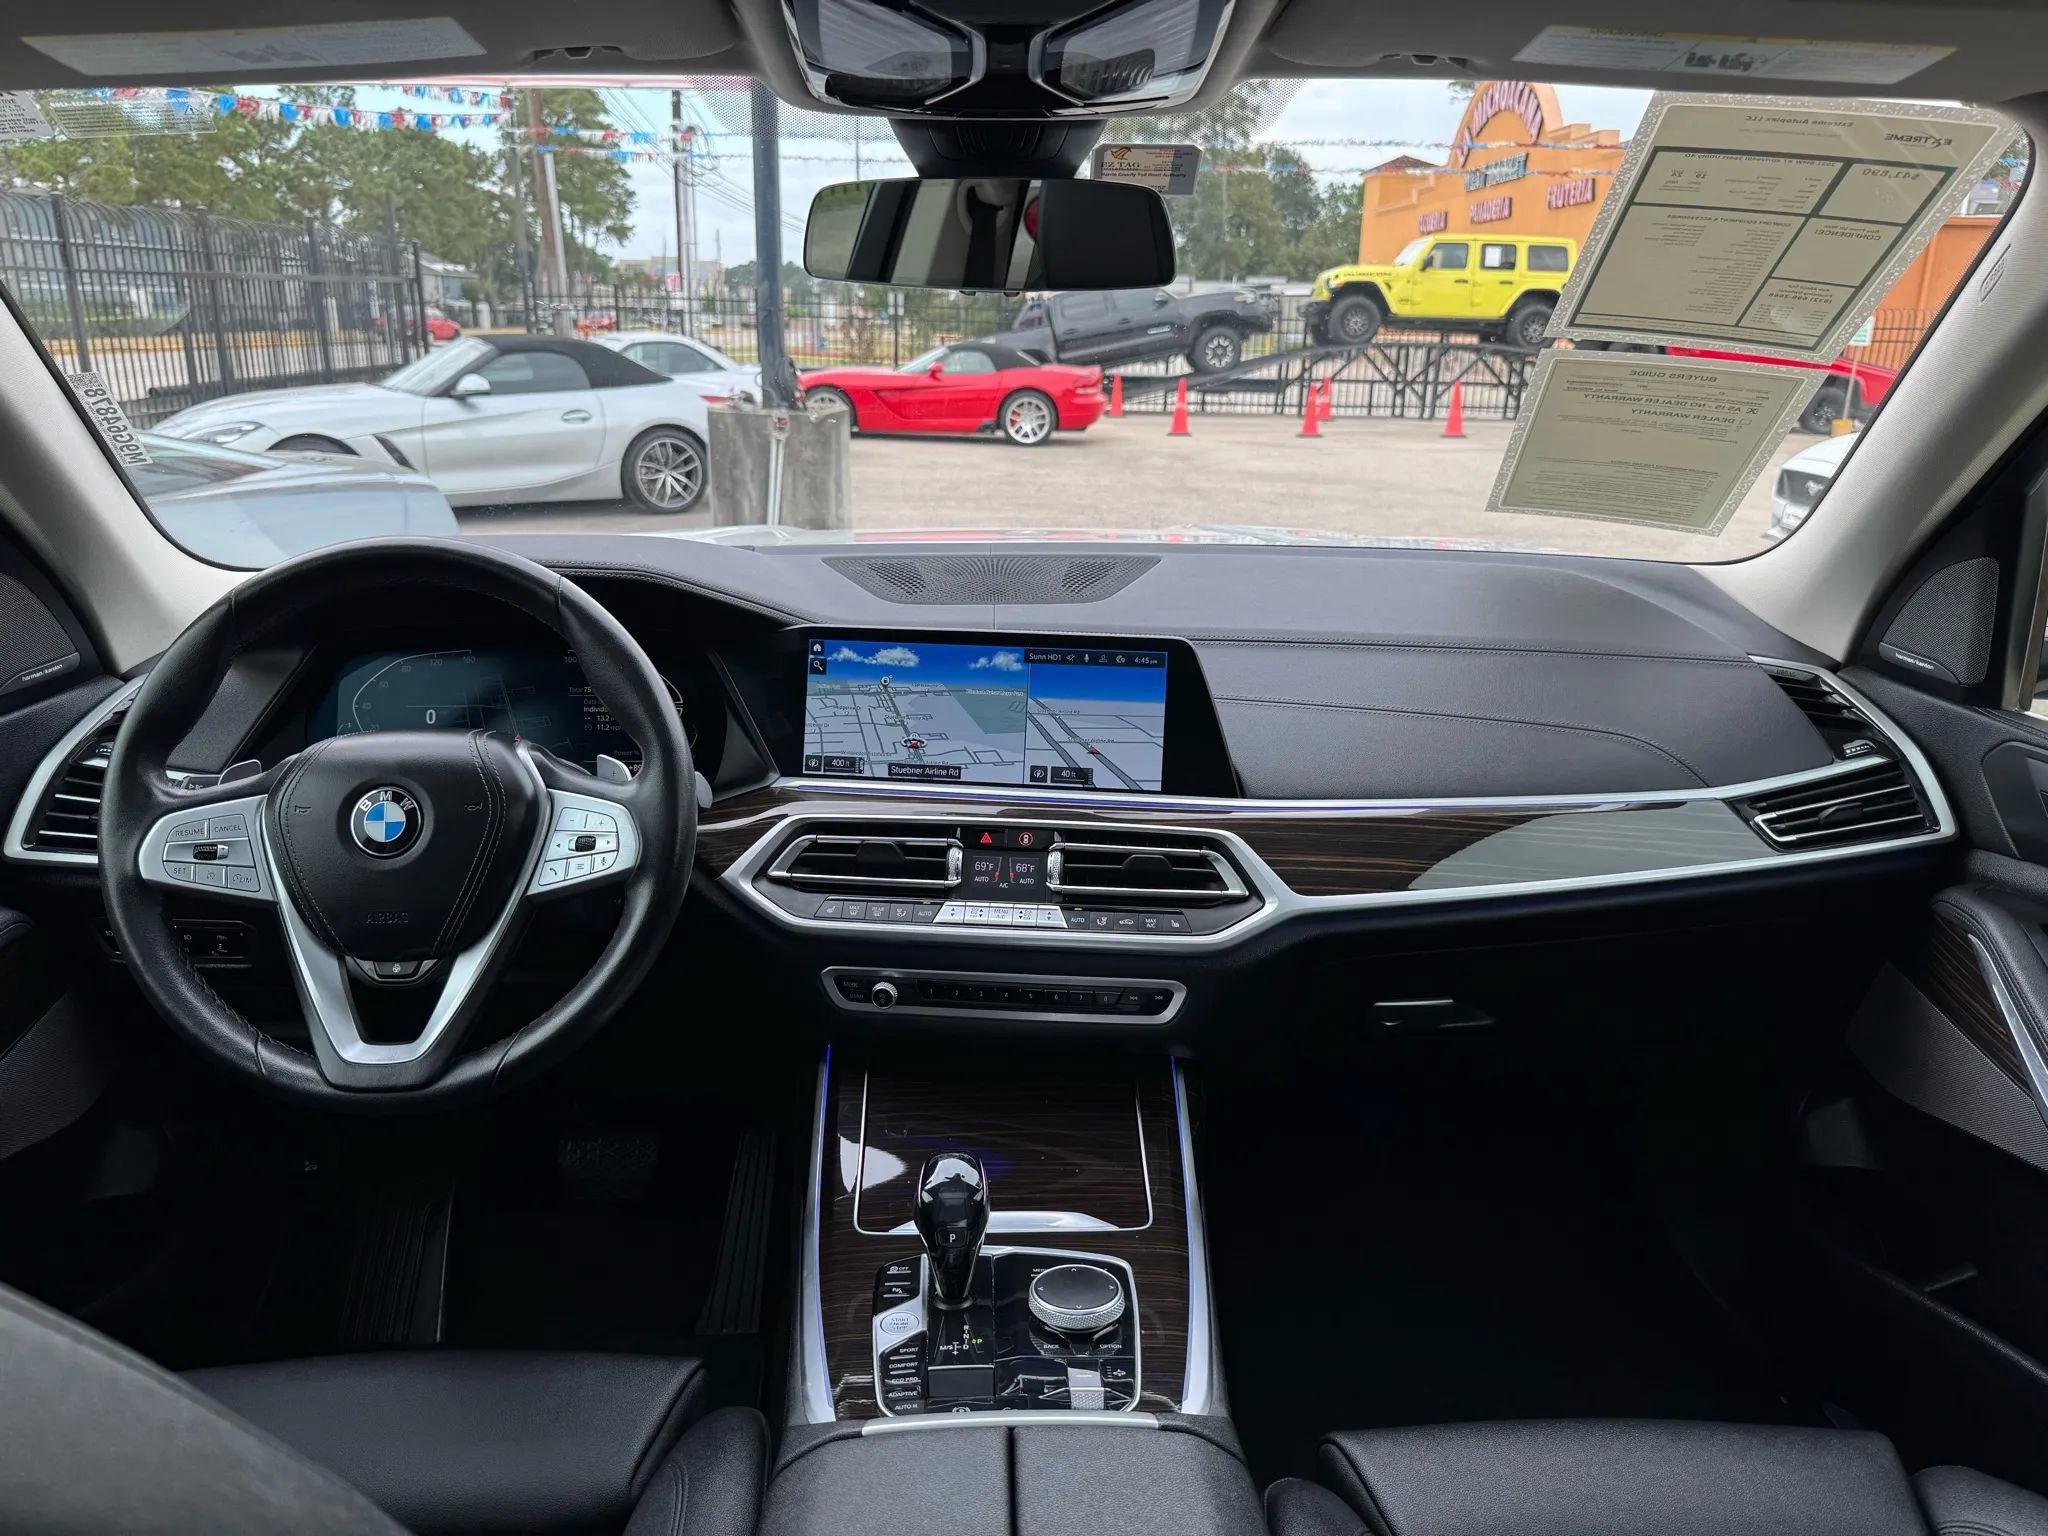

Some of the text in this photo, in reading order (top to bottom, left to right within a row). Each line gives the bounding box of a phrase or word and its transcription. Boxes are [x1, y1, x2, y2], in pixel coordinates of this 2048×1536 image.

[1029, 653, 1047, 661] Sunn
[22, 664, 63, 681] harman/kardon
[426, 709, 437, 724] 0
[831, 759, 845, 767] 400
[891, 766, 959, 777] Stuebner Airline Rd
[1061, 769, 1070, 778] 40
[360, 790, 414, 812] BMW
[175, 828, 205, 837] RESUME
[214, 825, 241, 833] CANCEL
[949, 1232, 956, 1243] P
[888, 1390, 919, 1398] ADAPTIVE
